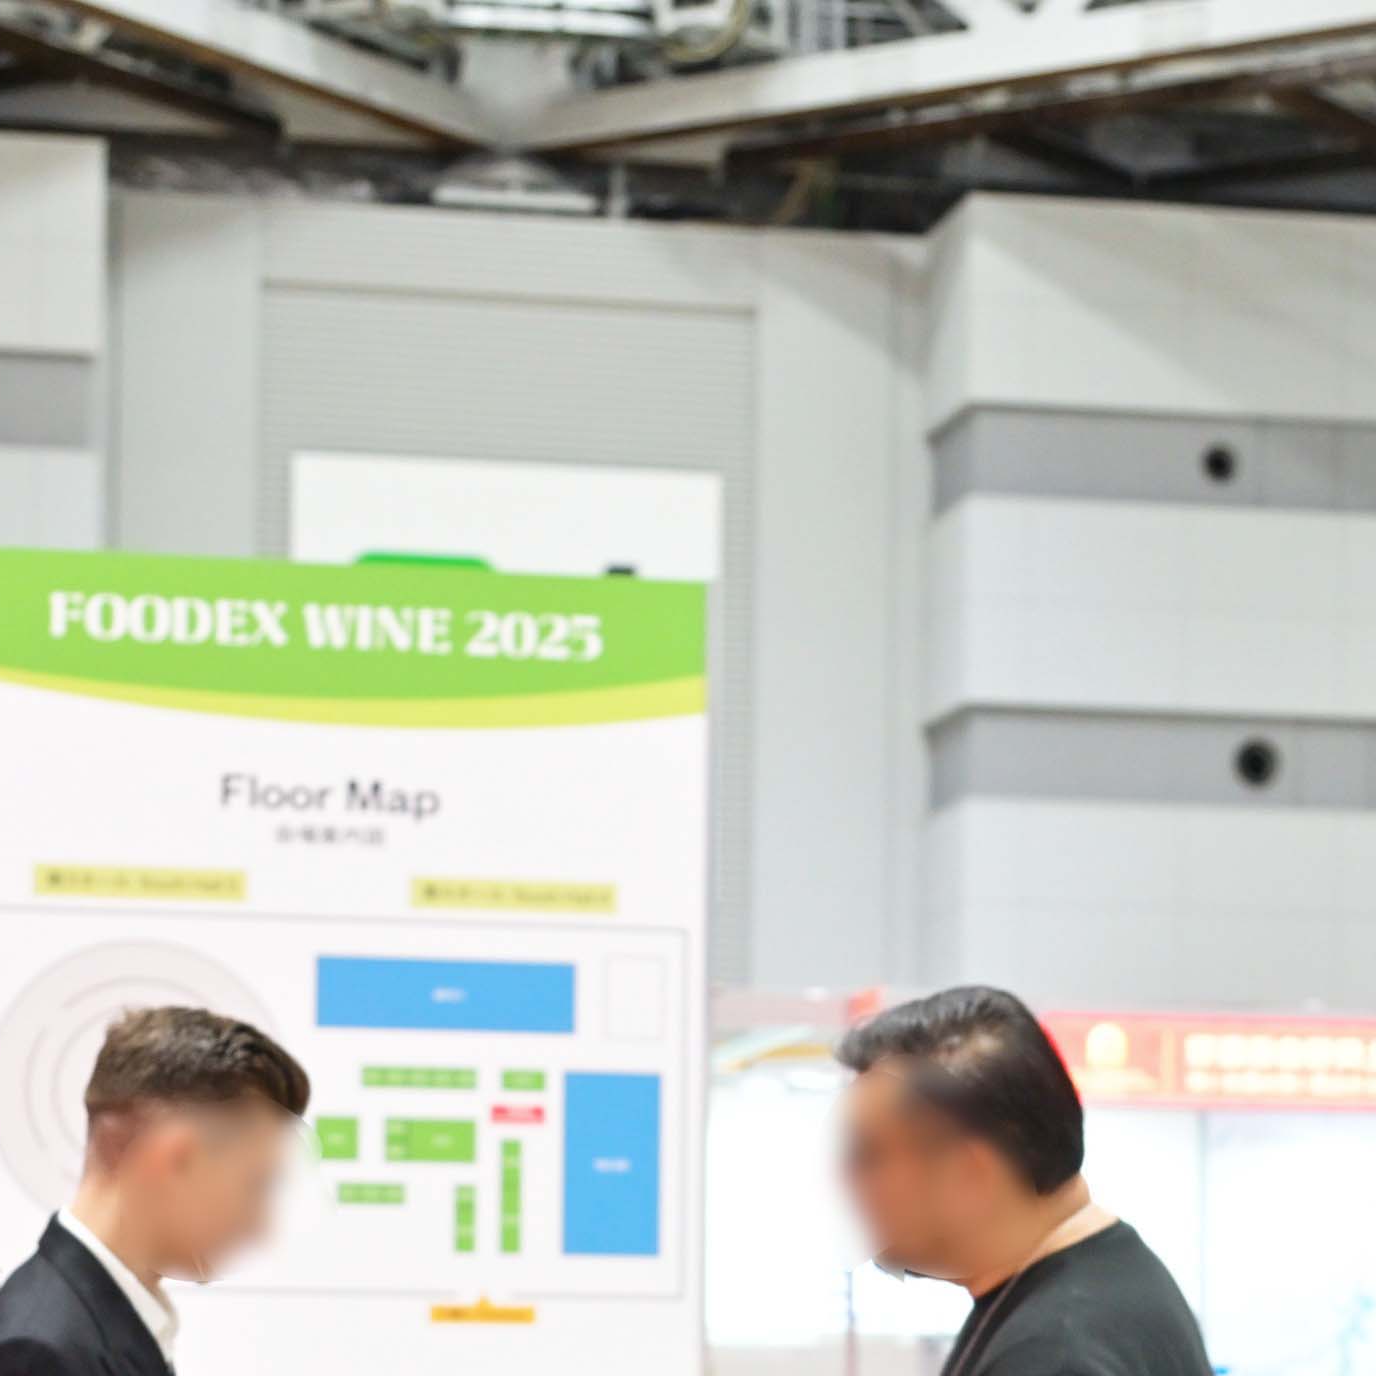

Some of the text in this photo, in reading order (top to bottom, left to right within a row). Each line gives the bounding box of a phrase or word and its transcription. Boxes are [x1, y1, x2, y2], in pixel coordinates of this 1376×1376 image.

[47, 590, 604, 662] FOODEX WINE 2025
[219, 771, 441, 825] Floor Map
